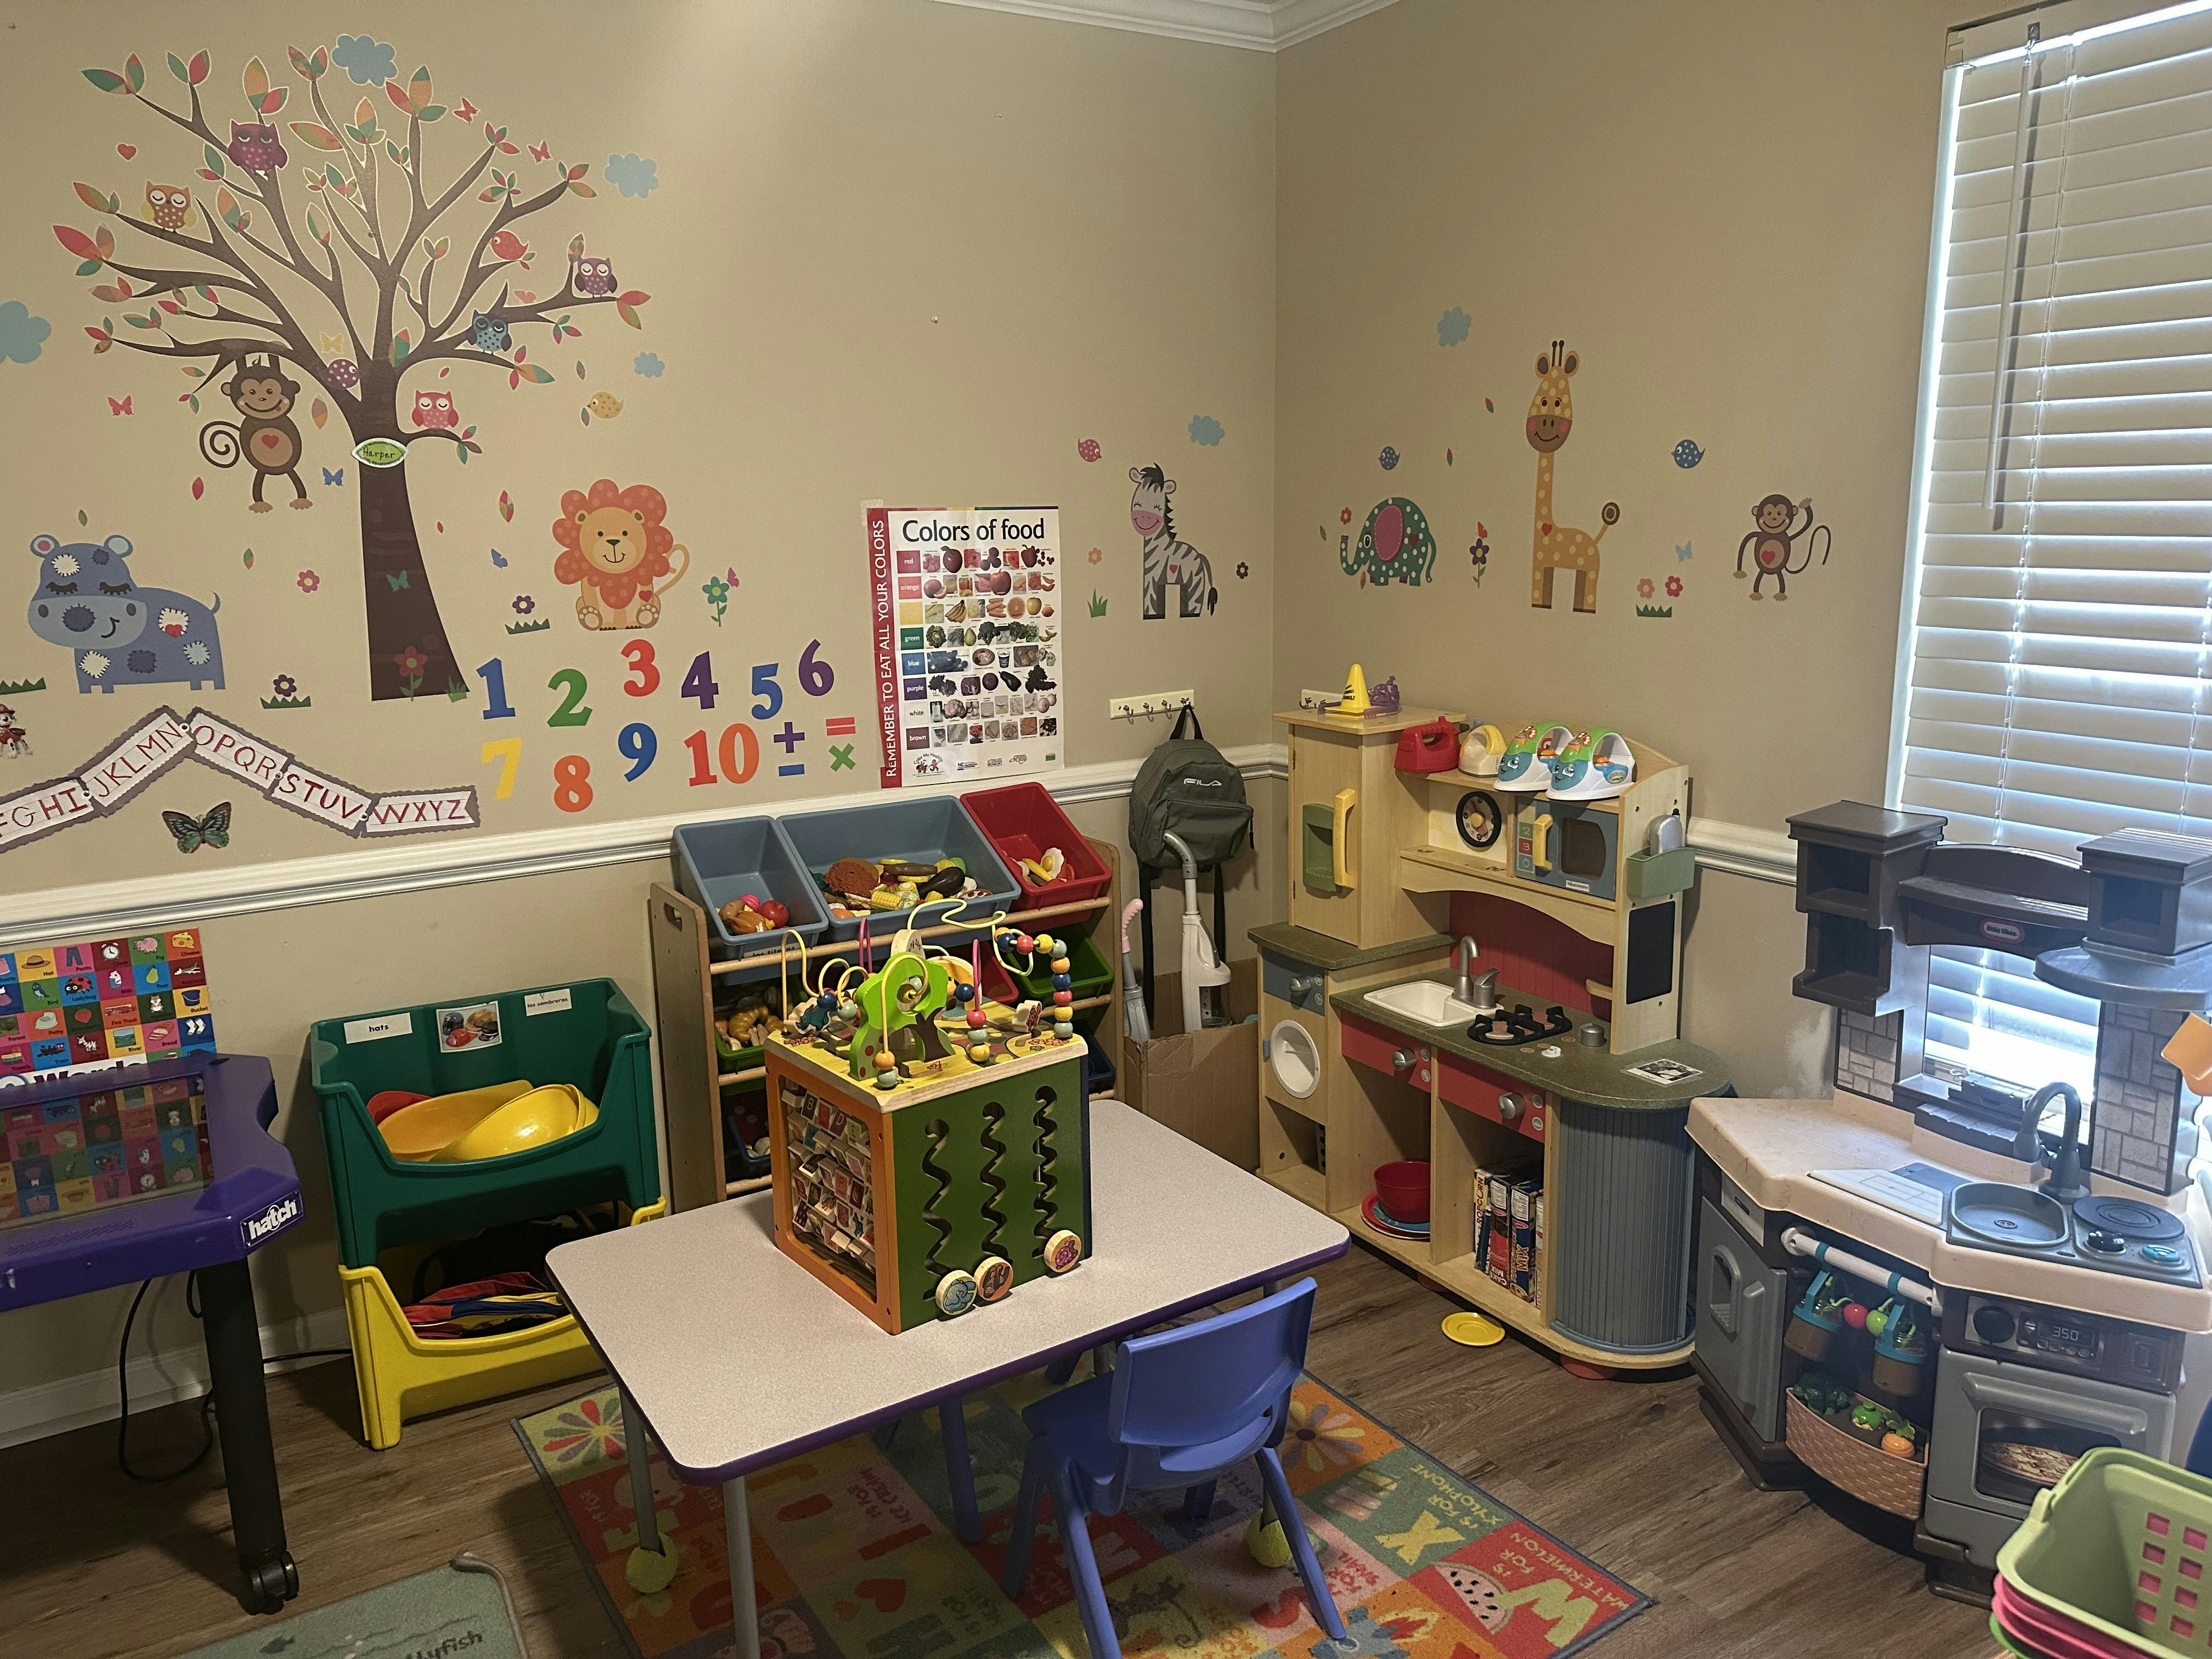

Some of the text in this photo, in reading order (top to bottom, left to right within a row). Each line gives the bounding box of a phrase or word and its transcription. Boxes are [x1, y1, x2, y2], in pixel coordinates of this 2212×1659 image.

[363, 446, 395, 460] Harper
[902, 518, 1045, 542] Colors of food
[900, 584, 919, 592] orange
[872, 520, 897, 777] REMEMBER TO EAT ALL YOUR COLORS
[476, 639, 834, 727] 1 2 3 4 5 6
[907, 685, 924, 693] purple
[98, 720, 182, 798] JKLMN
[191, 724, 278, 781] OPQR
[279, 774, 364, 820] STUV
[373, 799, 466, 825] WXYZ
[481, 737, 522, 800] 7
[554, 755, 594, 812] 8
[618, 723, 658, 782] 9
[684, 723, 759, 787] 10
[1184, 778, 1222, 786] FILA
[1522, 827, 1530, 835] 2
[1522, 843, 1530, 851] 3
[538, 997, 568, 1006] sombreros
[369, 1023, 389, 1033] hats
[249, 1200, 297, 1240] hatch
[1516, 1244, 1529, 1272] MIX
[1491, 1264, 1504, 1277] MIX
[2053, 1326, 2079, 1341] 350
[1410, 1464, 1504, 1526] XYLOPHONE
[1427, 1495, 1462, 1518] FOR
[1499, 1549, 1536, 1575] FOR
[1510, 1532, 1630, 1610] WATERMELON
